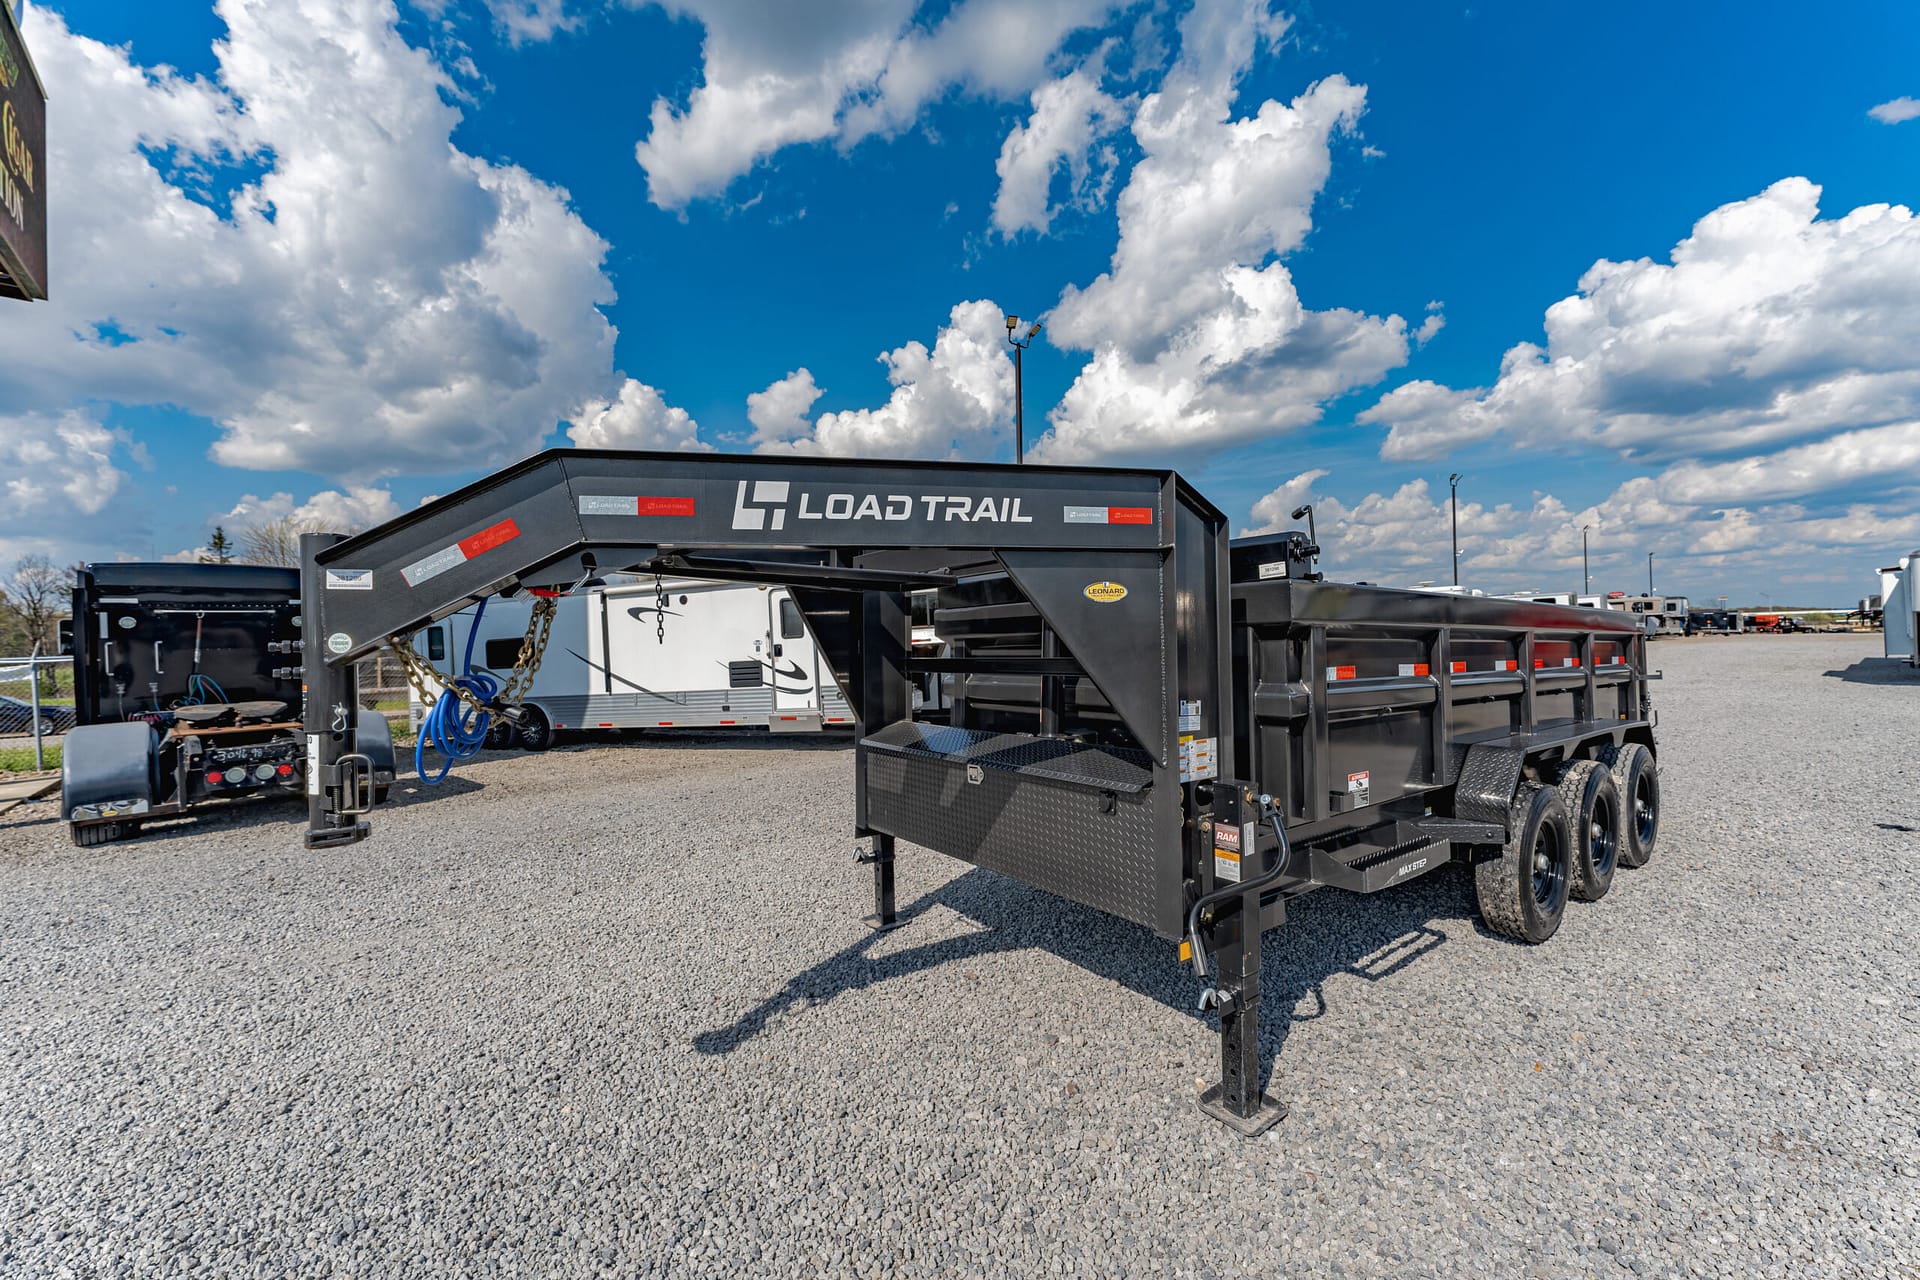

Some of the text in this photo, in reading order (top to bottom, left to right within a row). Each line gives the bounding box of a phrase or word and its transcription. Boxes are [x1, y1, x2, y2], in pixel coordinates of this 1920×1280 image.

[798, 493, 913, 521] LOAD
[920, 495, 1033, 523] TRAIL
[1216, 831, 1239, 843] RAM
[1399, 858, 1427, 876] MAX STEP
